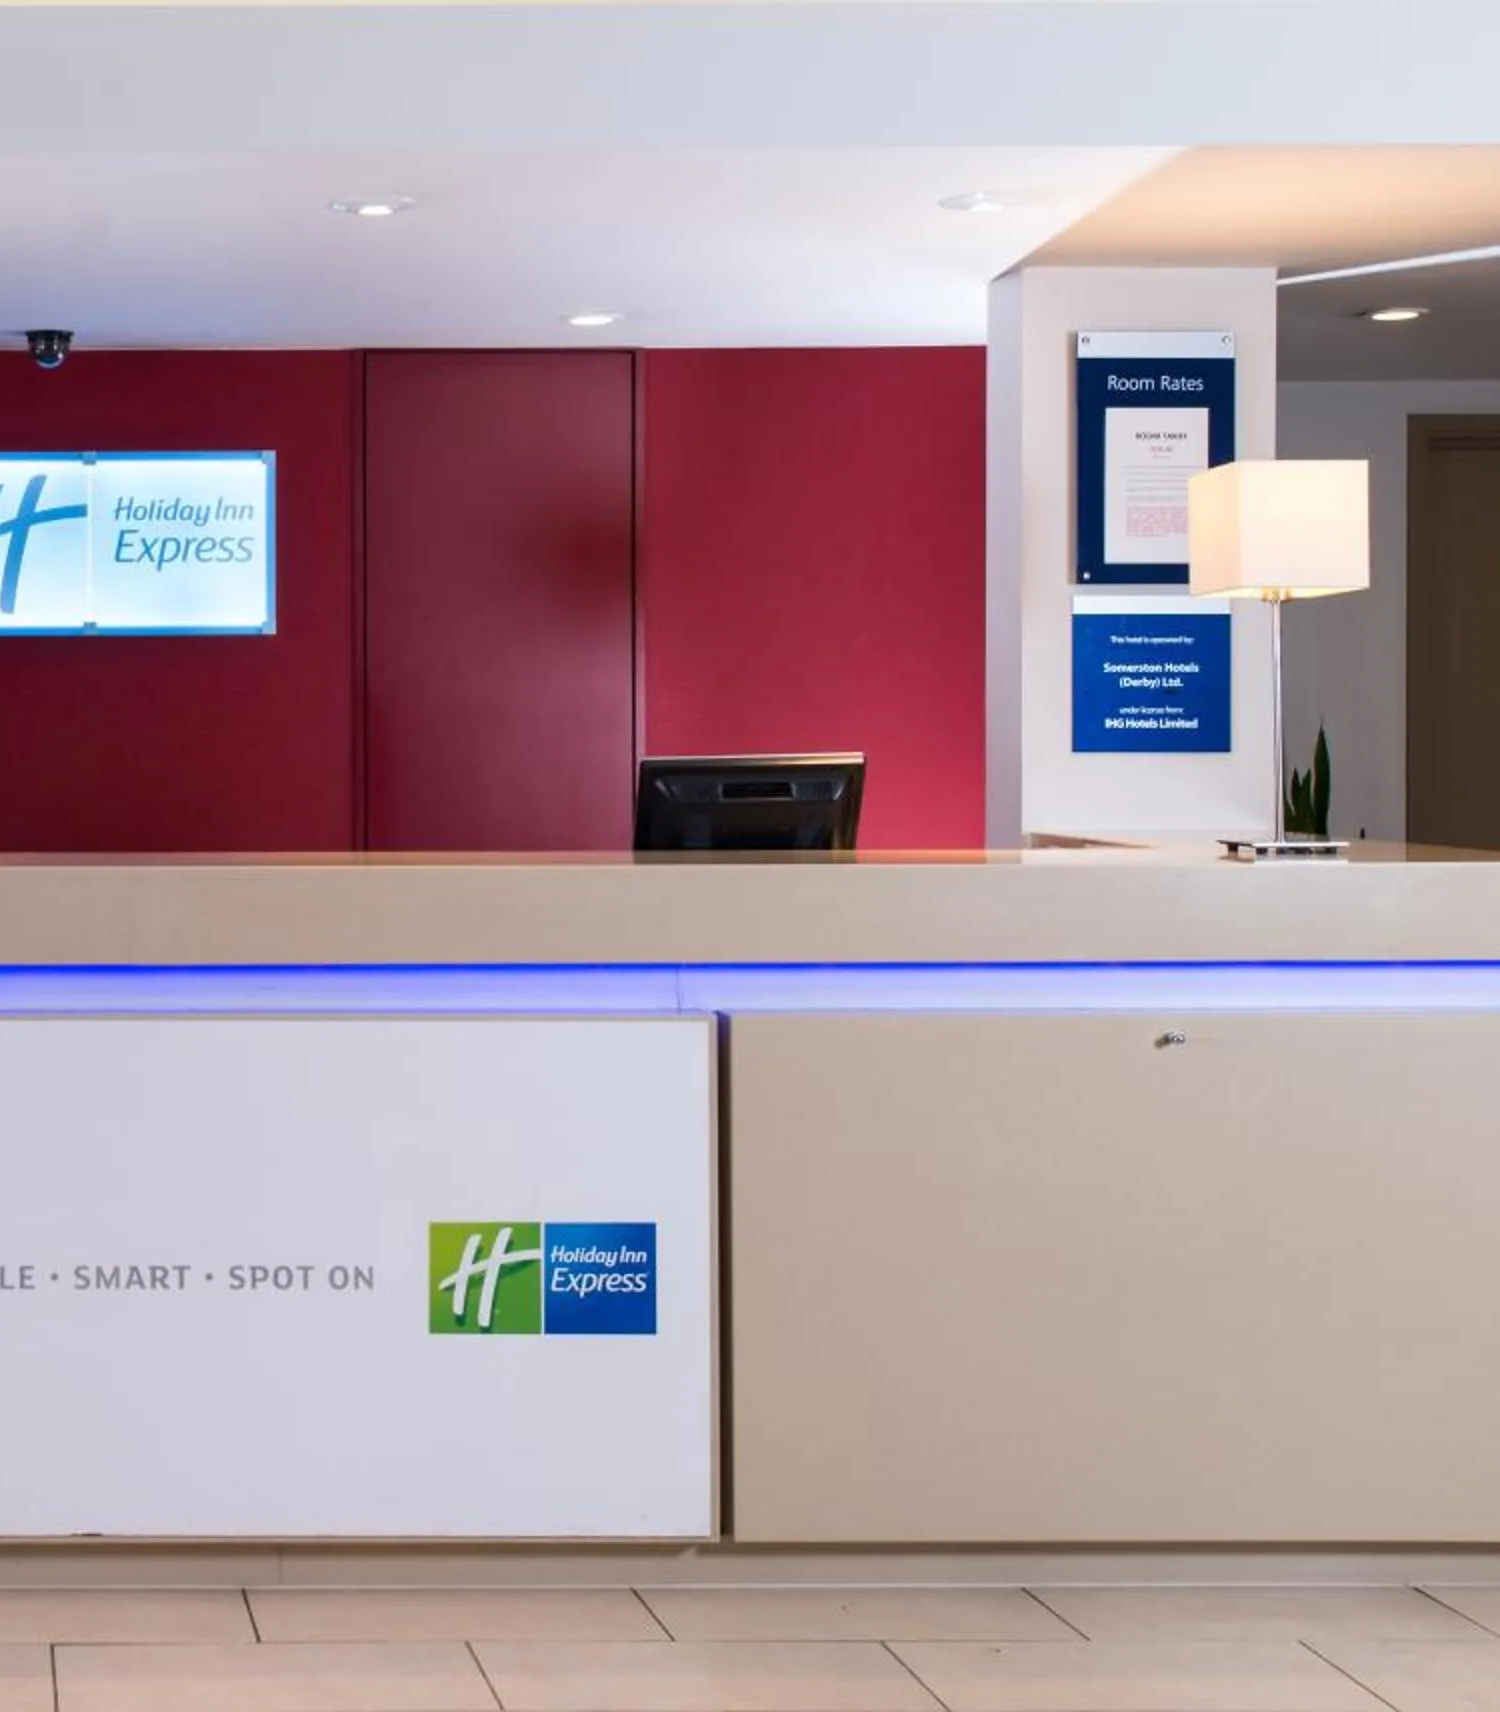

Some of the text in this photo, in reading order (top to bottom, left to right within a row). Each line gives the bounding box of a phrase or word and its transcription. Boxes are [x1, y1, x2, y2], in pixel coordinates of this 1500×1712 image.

[1106, 375, 1204, 391] Room Rates
[113, 497, 255, 527] Holiday Inn
[113, 529, 255, 572] Express
[1103, 662, 1199, 673] Somerston Hotels
[1119, 677, 1184, 688] (Derby) Ltd.
[1105, 718, 1199, 729] IHG Hotels Limited
[550, 1245, 647, 1267] Holiday Inn
[73, 1265, 191, 1290] SMART
[228, 1265, 315, 1290] SPOT
[328, 1265, 375, 1290] ON
[550, 1268, 648, 1298] Express
